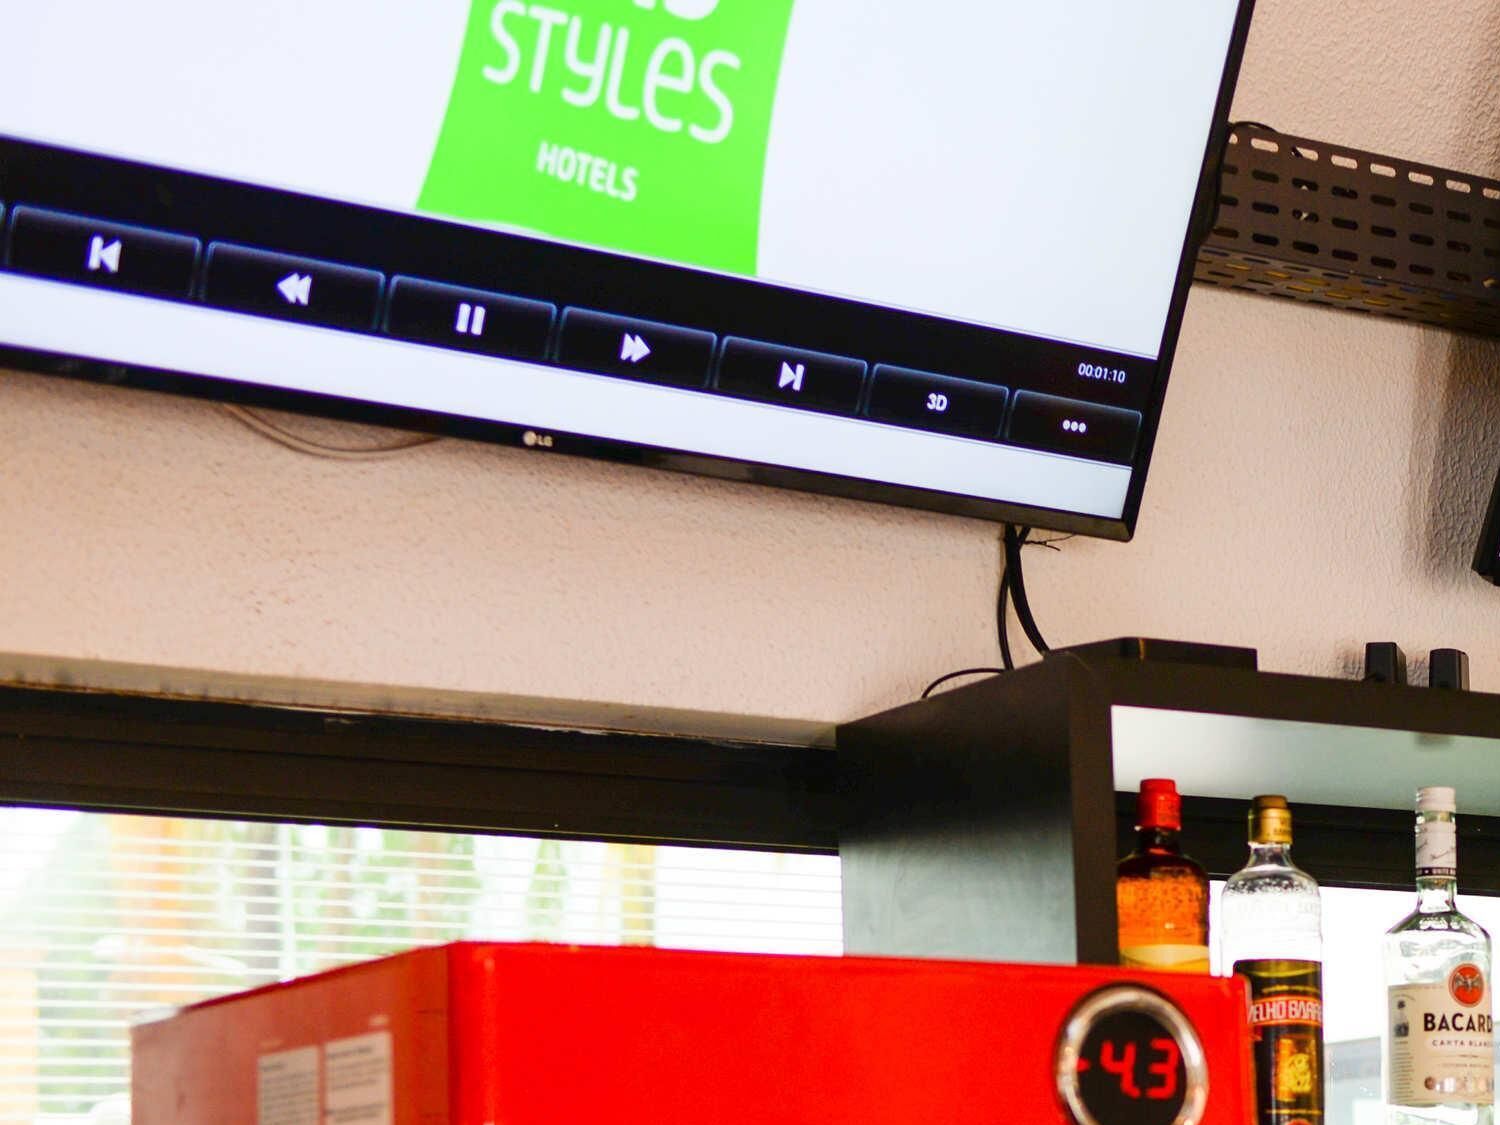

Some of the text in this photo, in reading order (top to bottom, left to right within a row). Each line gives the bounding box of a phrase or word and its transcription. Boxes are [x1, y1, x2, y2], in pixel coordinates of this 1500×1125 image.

[536, 141, 639, 201] HOTELS
[926, 393, 948, 413] 3D
[537, 434, 553, 448] LG
